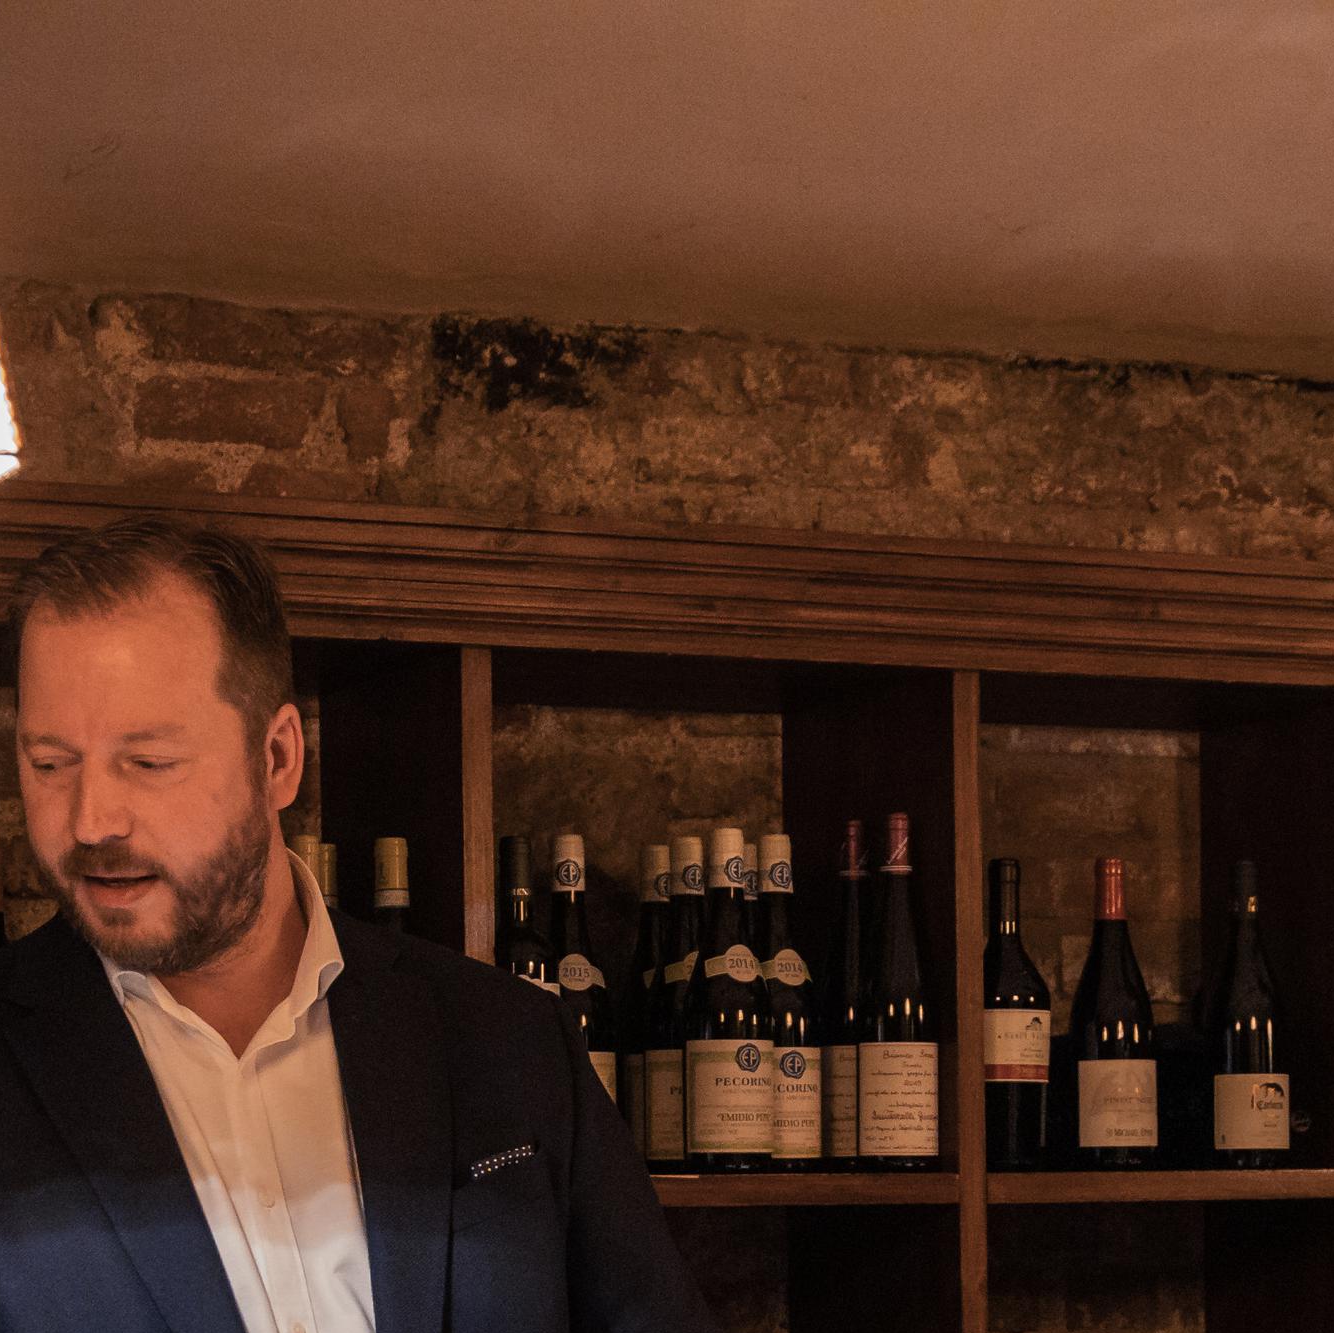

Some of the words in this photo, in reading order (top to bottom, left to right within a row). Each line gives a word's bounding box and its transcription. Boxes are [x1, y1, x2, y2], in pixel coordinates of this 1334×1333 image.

[728, 958, 755, 970] 2014
[777, 963, 803, 974] 2014
[563, 967, 590, 978] 2015
